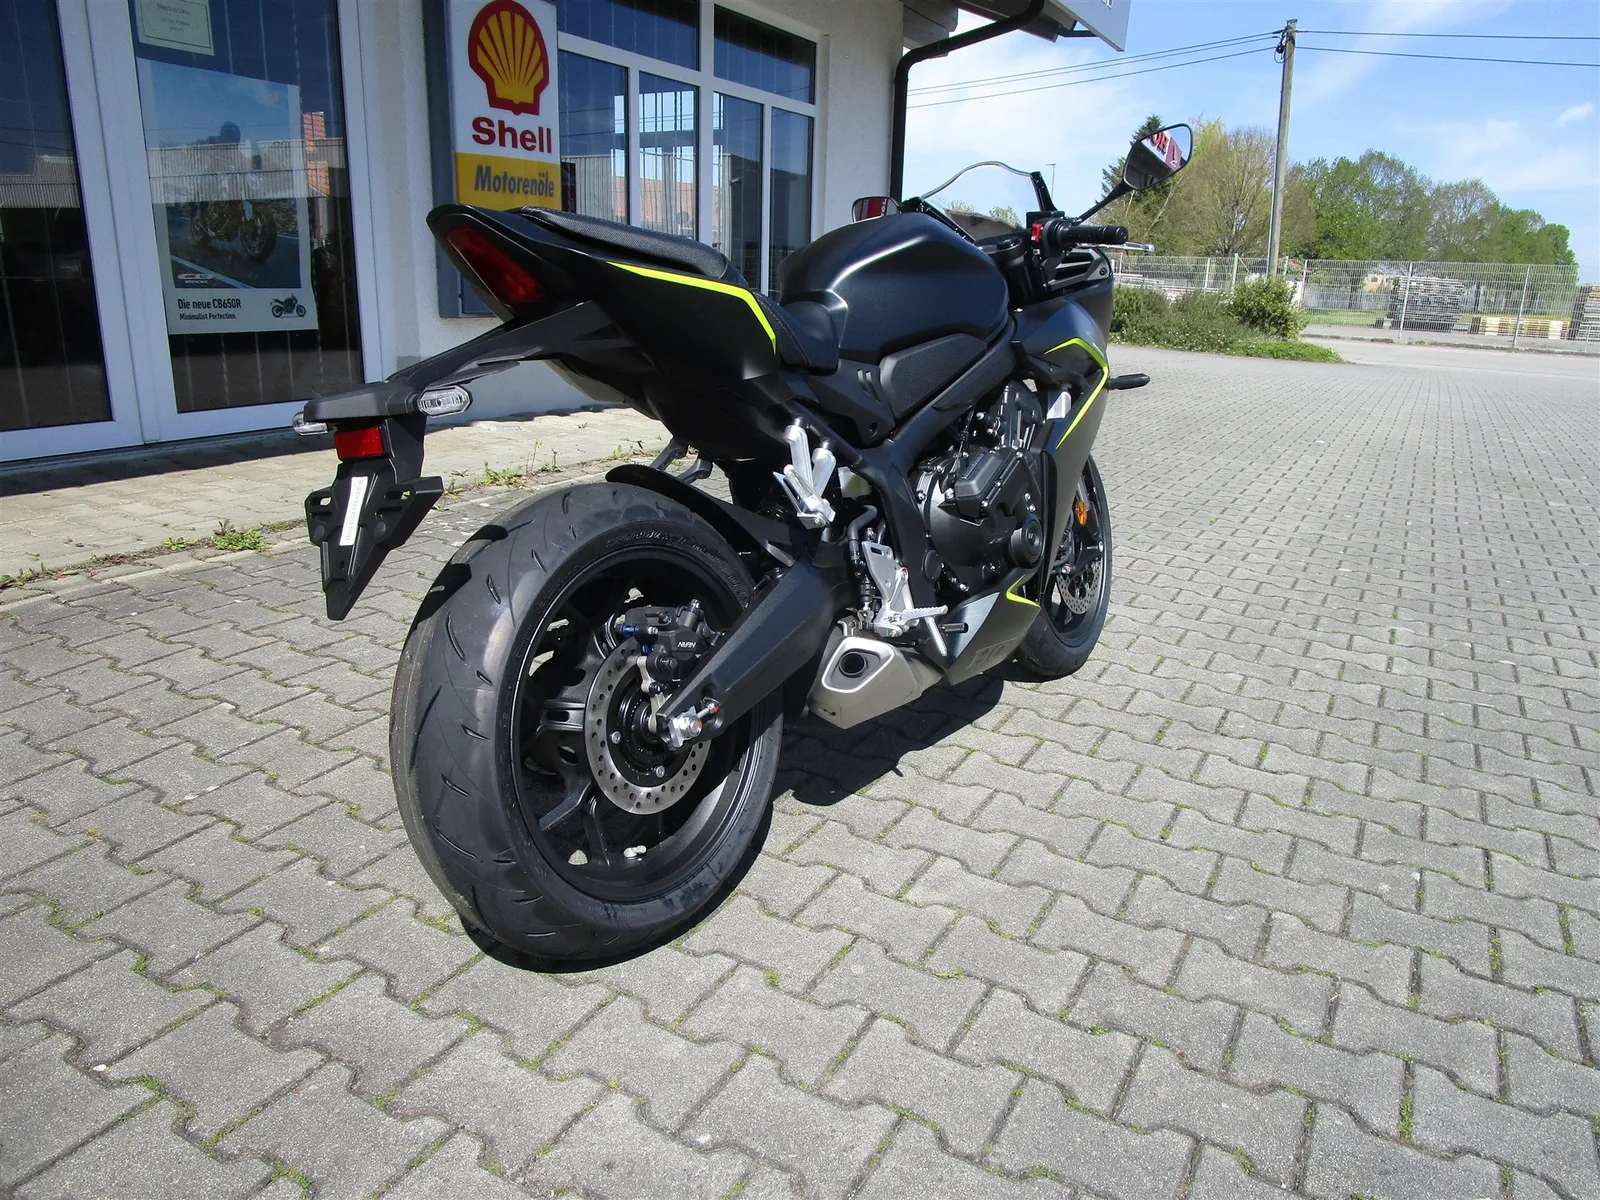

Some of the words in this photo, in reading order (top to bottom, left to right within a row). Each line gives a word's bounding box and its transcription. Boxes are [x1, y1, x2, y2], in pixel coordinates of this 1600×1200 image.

[472, 116, 552, 154] Shell
[474, 164, 555, 198] Motorenöle
[177, 298, 191, 310] Die
[192, 300, 212, 310] neue
[212, 298, 242, 309] CB650R
[179, 312, 208, 320] Minimalist
